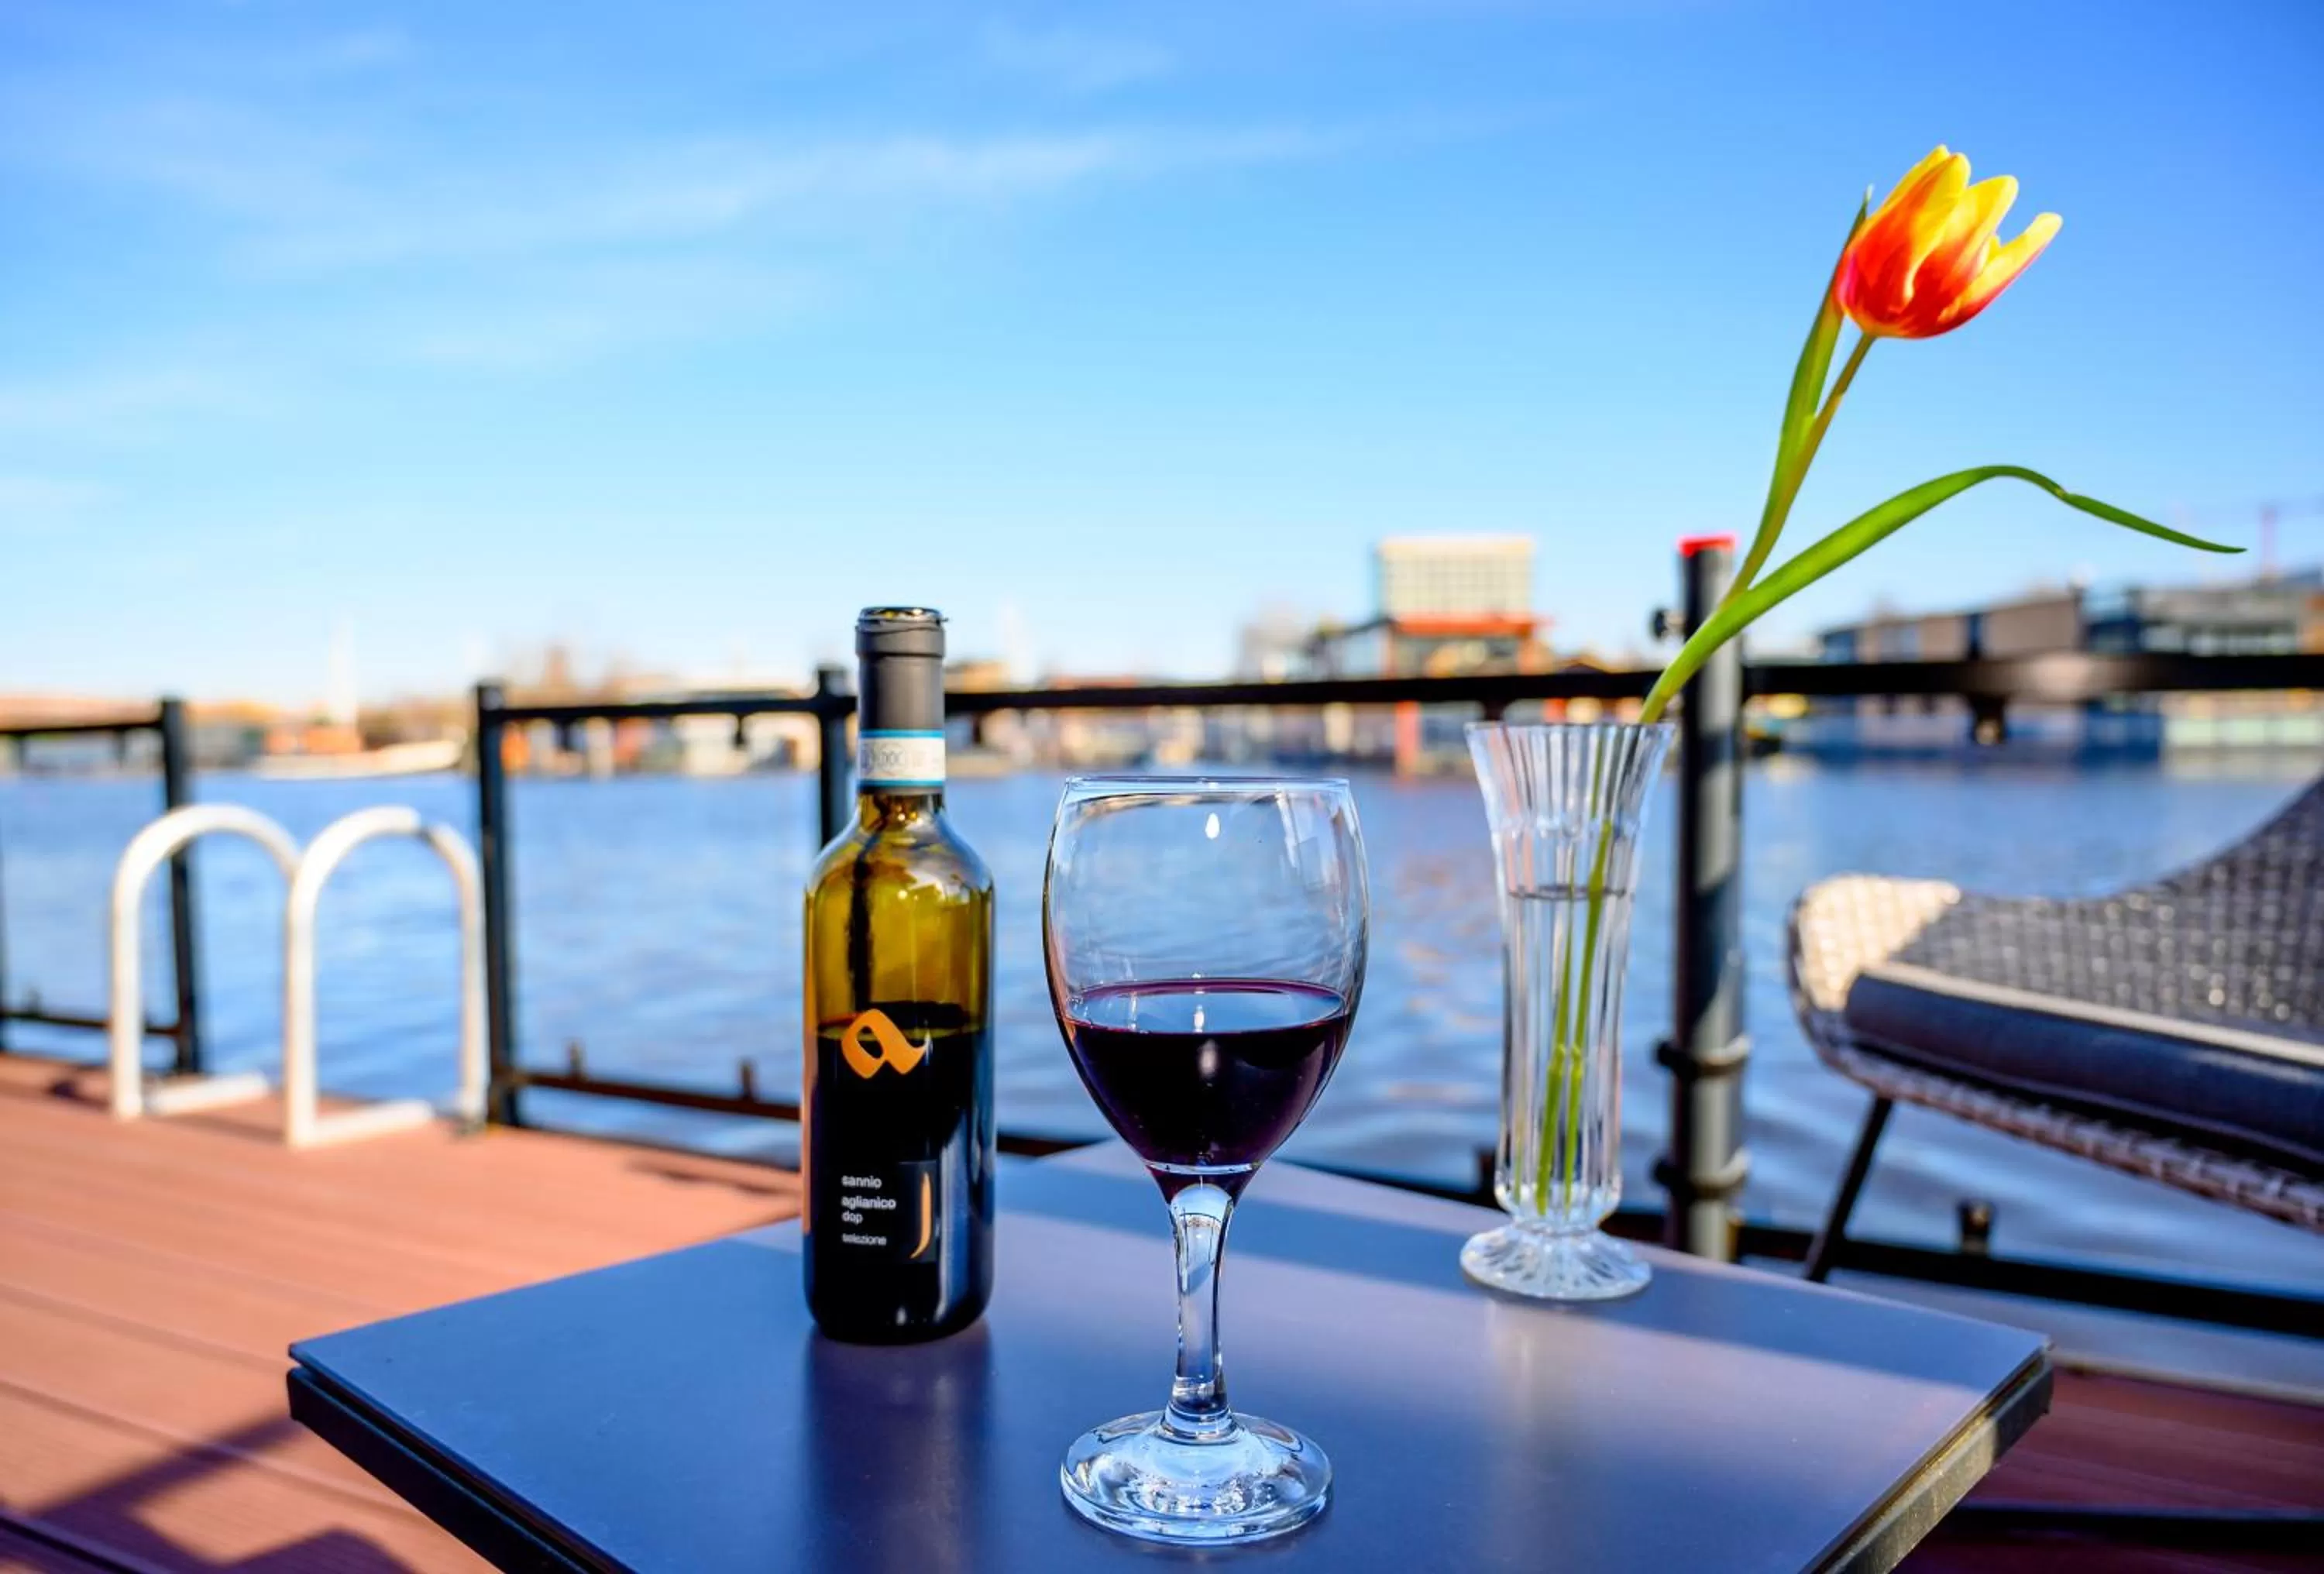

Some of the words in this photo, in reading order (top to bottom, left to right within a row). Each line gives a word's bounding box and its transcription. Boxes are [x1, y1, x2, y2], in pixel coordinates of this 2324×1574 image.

[841, 1175, 882, 1189] sannio
[841, 1195, 897, 1210] aglianico
[841, 1210, 864, 1225] dop
